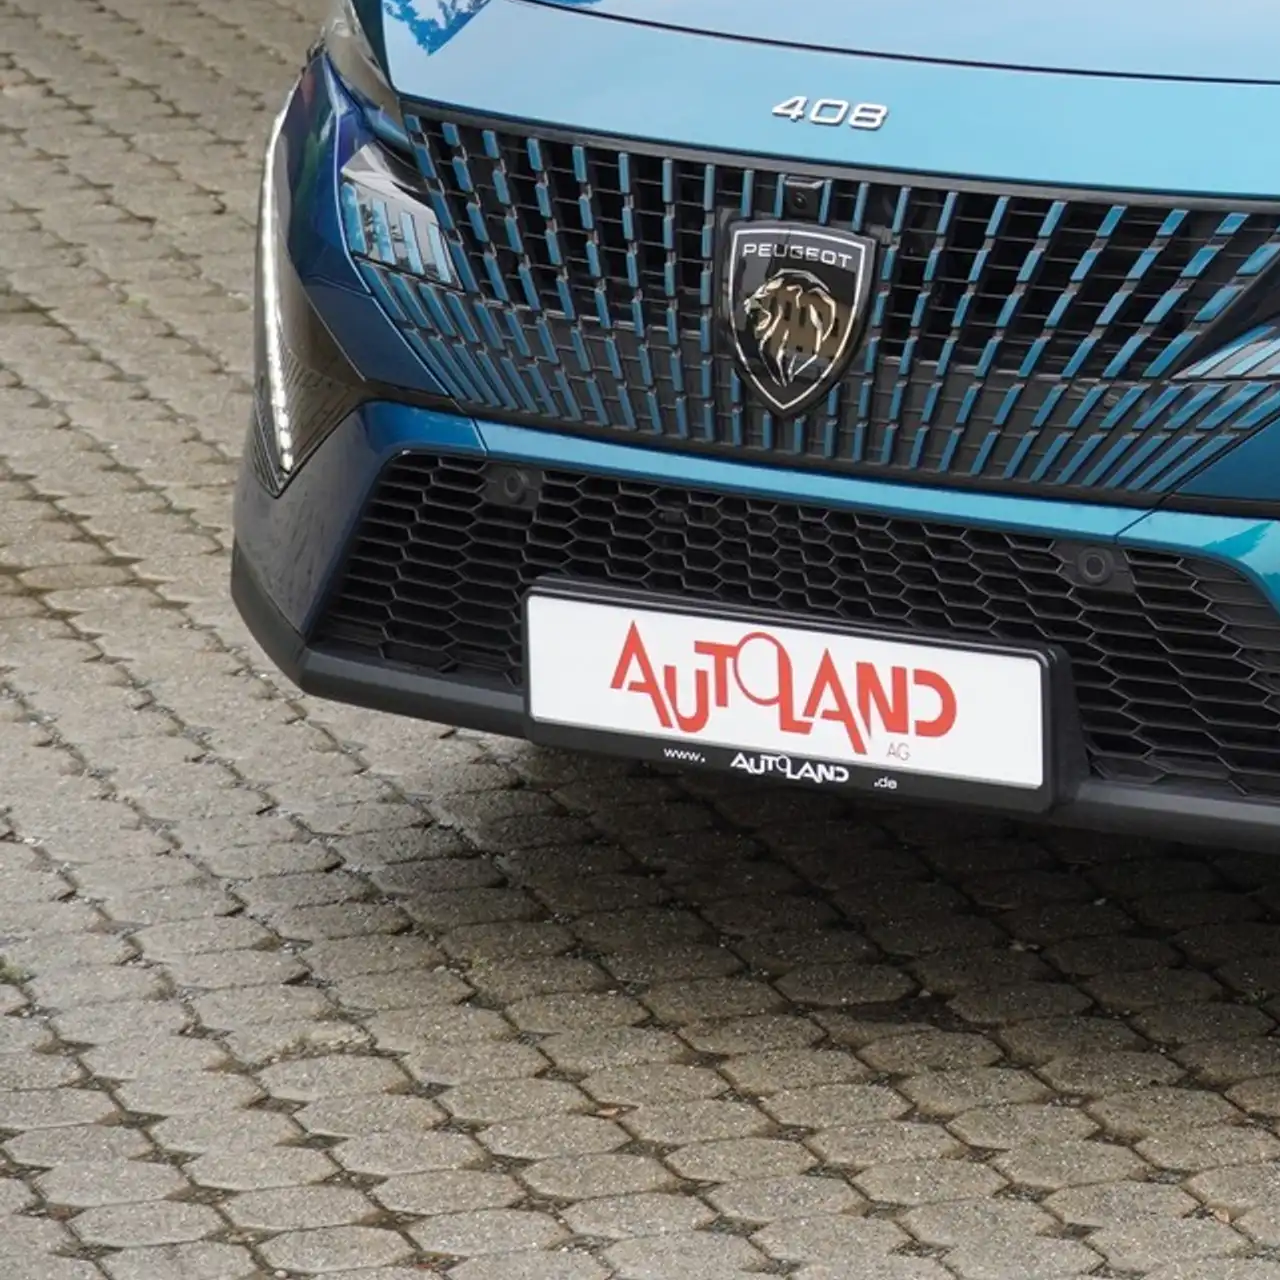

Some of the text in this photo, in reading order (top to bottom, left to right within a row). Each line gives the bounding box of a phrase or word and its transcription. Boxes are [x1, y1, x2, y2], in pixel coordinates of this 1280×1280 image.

[771, 95, 889, 130] 408
[742, 242, 853, 268] PEUGEOT
[885, 741, 911, 761] AG
